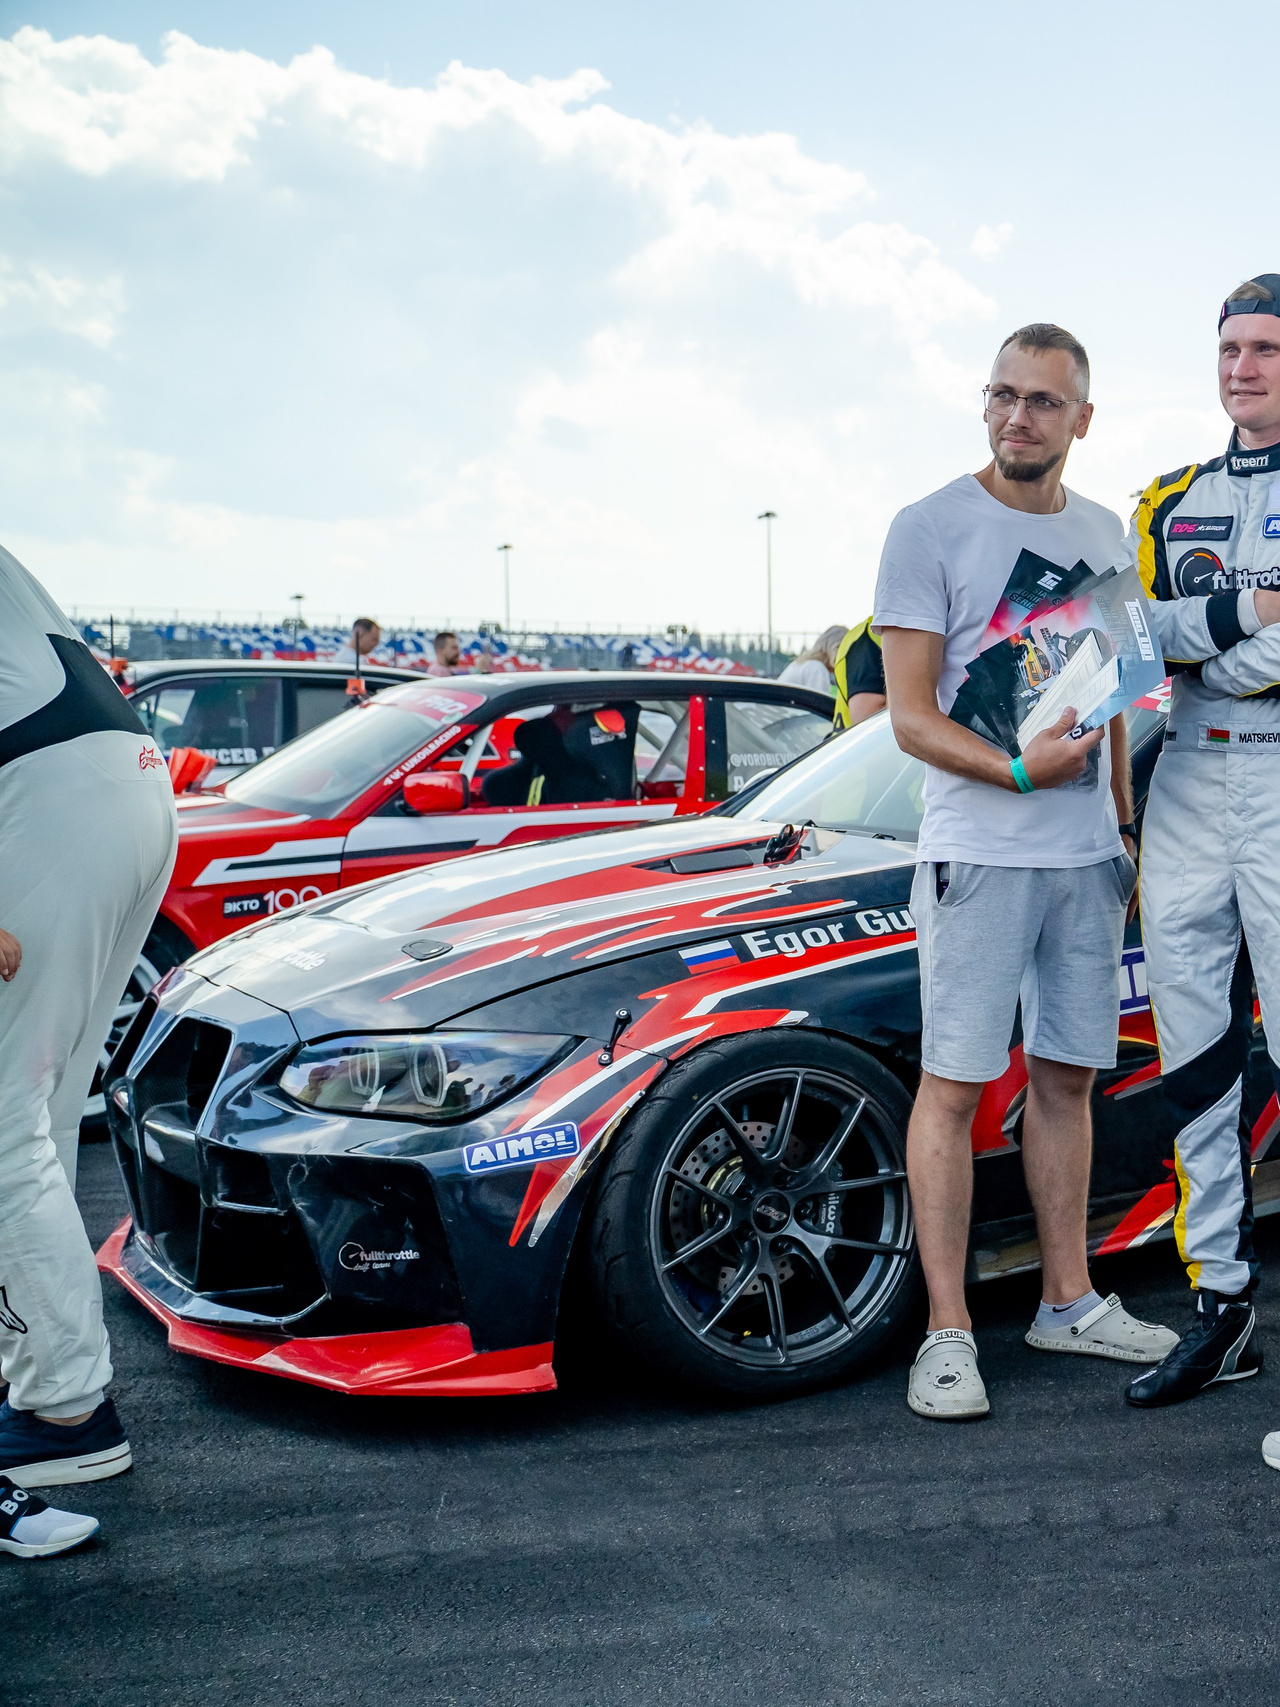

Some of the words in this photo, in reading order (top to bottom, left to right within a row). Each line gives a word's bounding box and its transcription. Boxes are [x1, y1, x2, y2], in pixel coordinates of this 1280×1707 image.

[1230, 454, 1269, 470] freem
[1171, 523, 1198, 533] RDS
[1010, 594, 1037, 611] SERIE
[1021, 590, 1043, 605] DRIF
[224, 899, 260, 914] ЭКТО
[263, 885, 323, 914] 100
[741, 922, 845, 958] Egor
[855, 906, 917, 936] Gu
[470, 1129, 574, 1166] AIMOL
[360, 1249, 420, 1262] fullthrottle
[0, 1489, 29, 1515] BO
